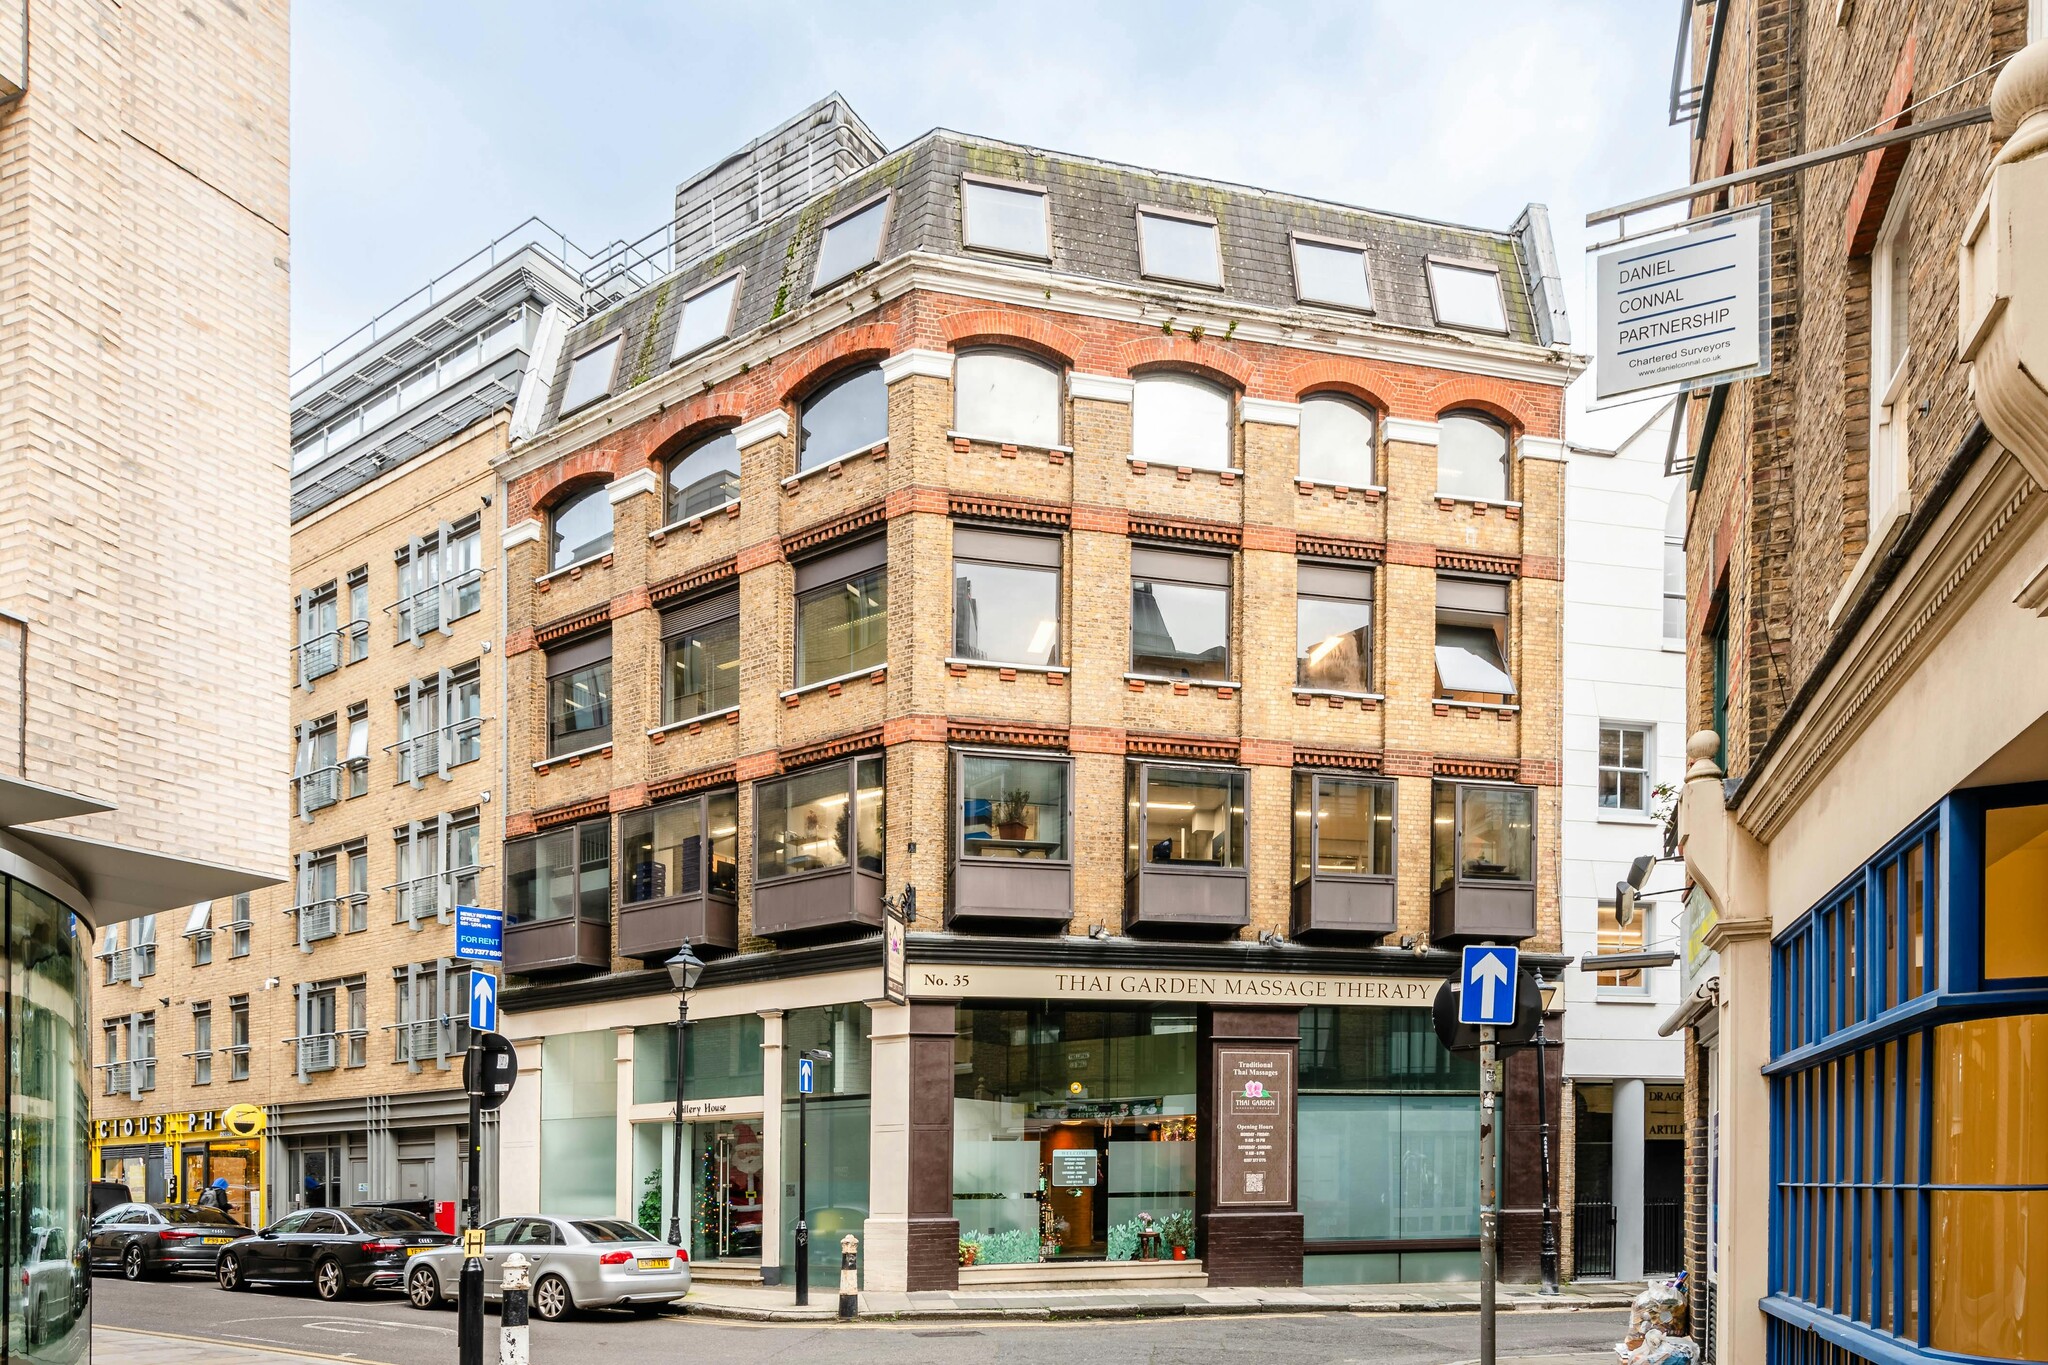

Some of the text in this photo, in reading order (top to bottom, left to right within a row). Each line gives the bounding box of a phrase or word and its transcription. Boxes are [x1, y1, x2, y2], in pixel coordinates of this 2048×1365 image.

[1620, 260, 1675, 284] DANIEL
[1619, 288, 1684, 314] CONNAL
[1619, 308, 1730, 344] PARTNERSHIP
[1629, 340, 1730, 368] Chartered Surveyors
[1638, 355, 1721, 377] www.danielconnal.co.uk
[461, 935, 477, 943] FOR
[924, 973, 970, 986] No. 35
[1055, 974, 1112, 991] THAI
[1120, 976, 1216, 994] GARDEN
[1224, 979, 1327, 997] MASSAGE
[1334, 982, 1431, 999] THERAPY
[1249, 1069, 1278, 1077] Massages
[704, 1103, 727, 1113] House
[98, 1115, 165, 1138] CIOUS
[704, 1132, 712, 1142] 35
[466, 1233, 483, 1254] H
